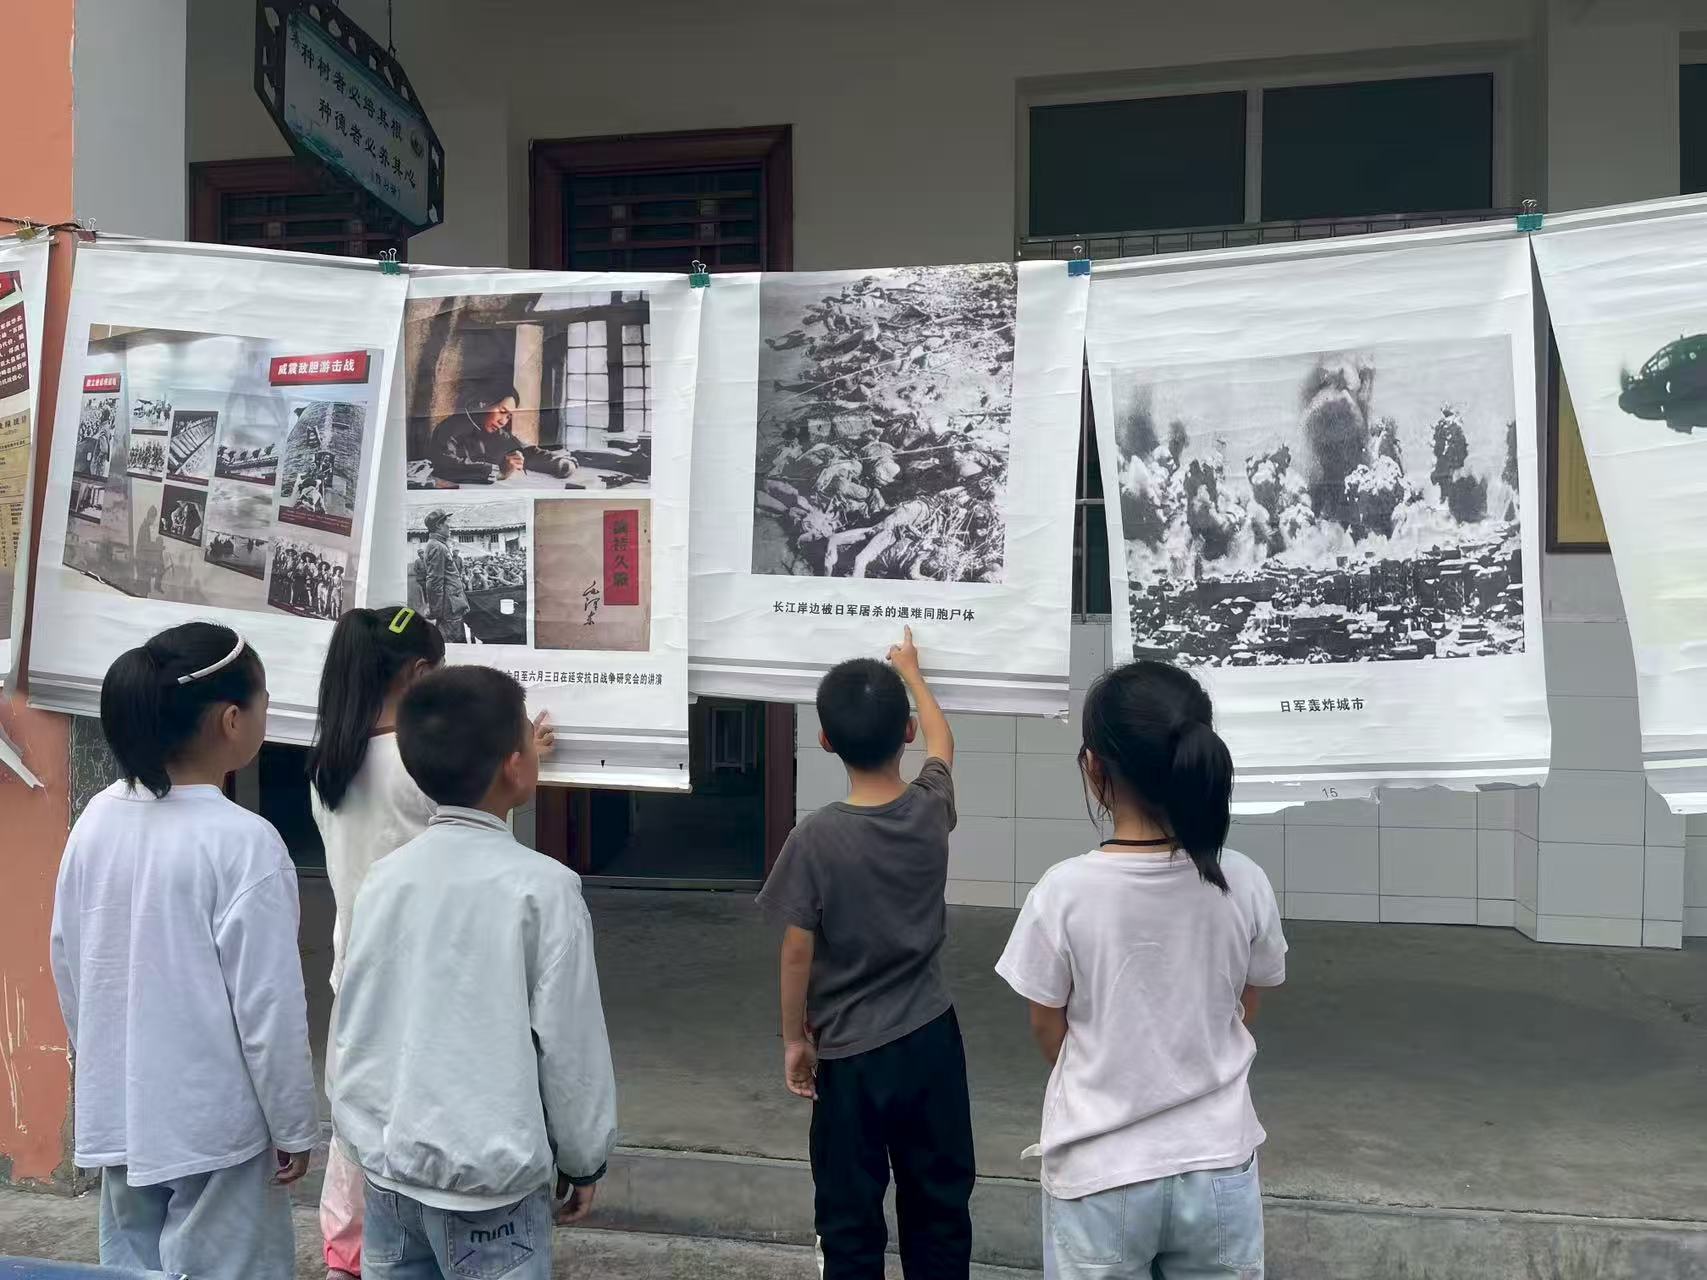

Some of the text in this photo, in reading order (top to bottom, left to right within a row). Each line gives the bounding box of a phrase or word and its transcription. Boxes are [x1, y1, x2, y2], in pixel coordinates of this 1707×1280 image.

[278, 359, 355, 376] 威震敌胆游击战
[773, 600, 975, 621] 长江岸边被日军屠杀的遇难同胞尸体
[1280, 697, 1365, 713] 日军轰炸城市
[1321, 786, 1338, 799] 15
[470, 1221, 515, 1243] mini
